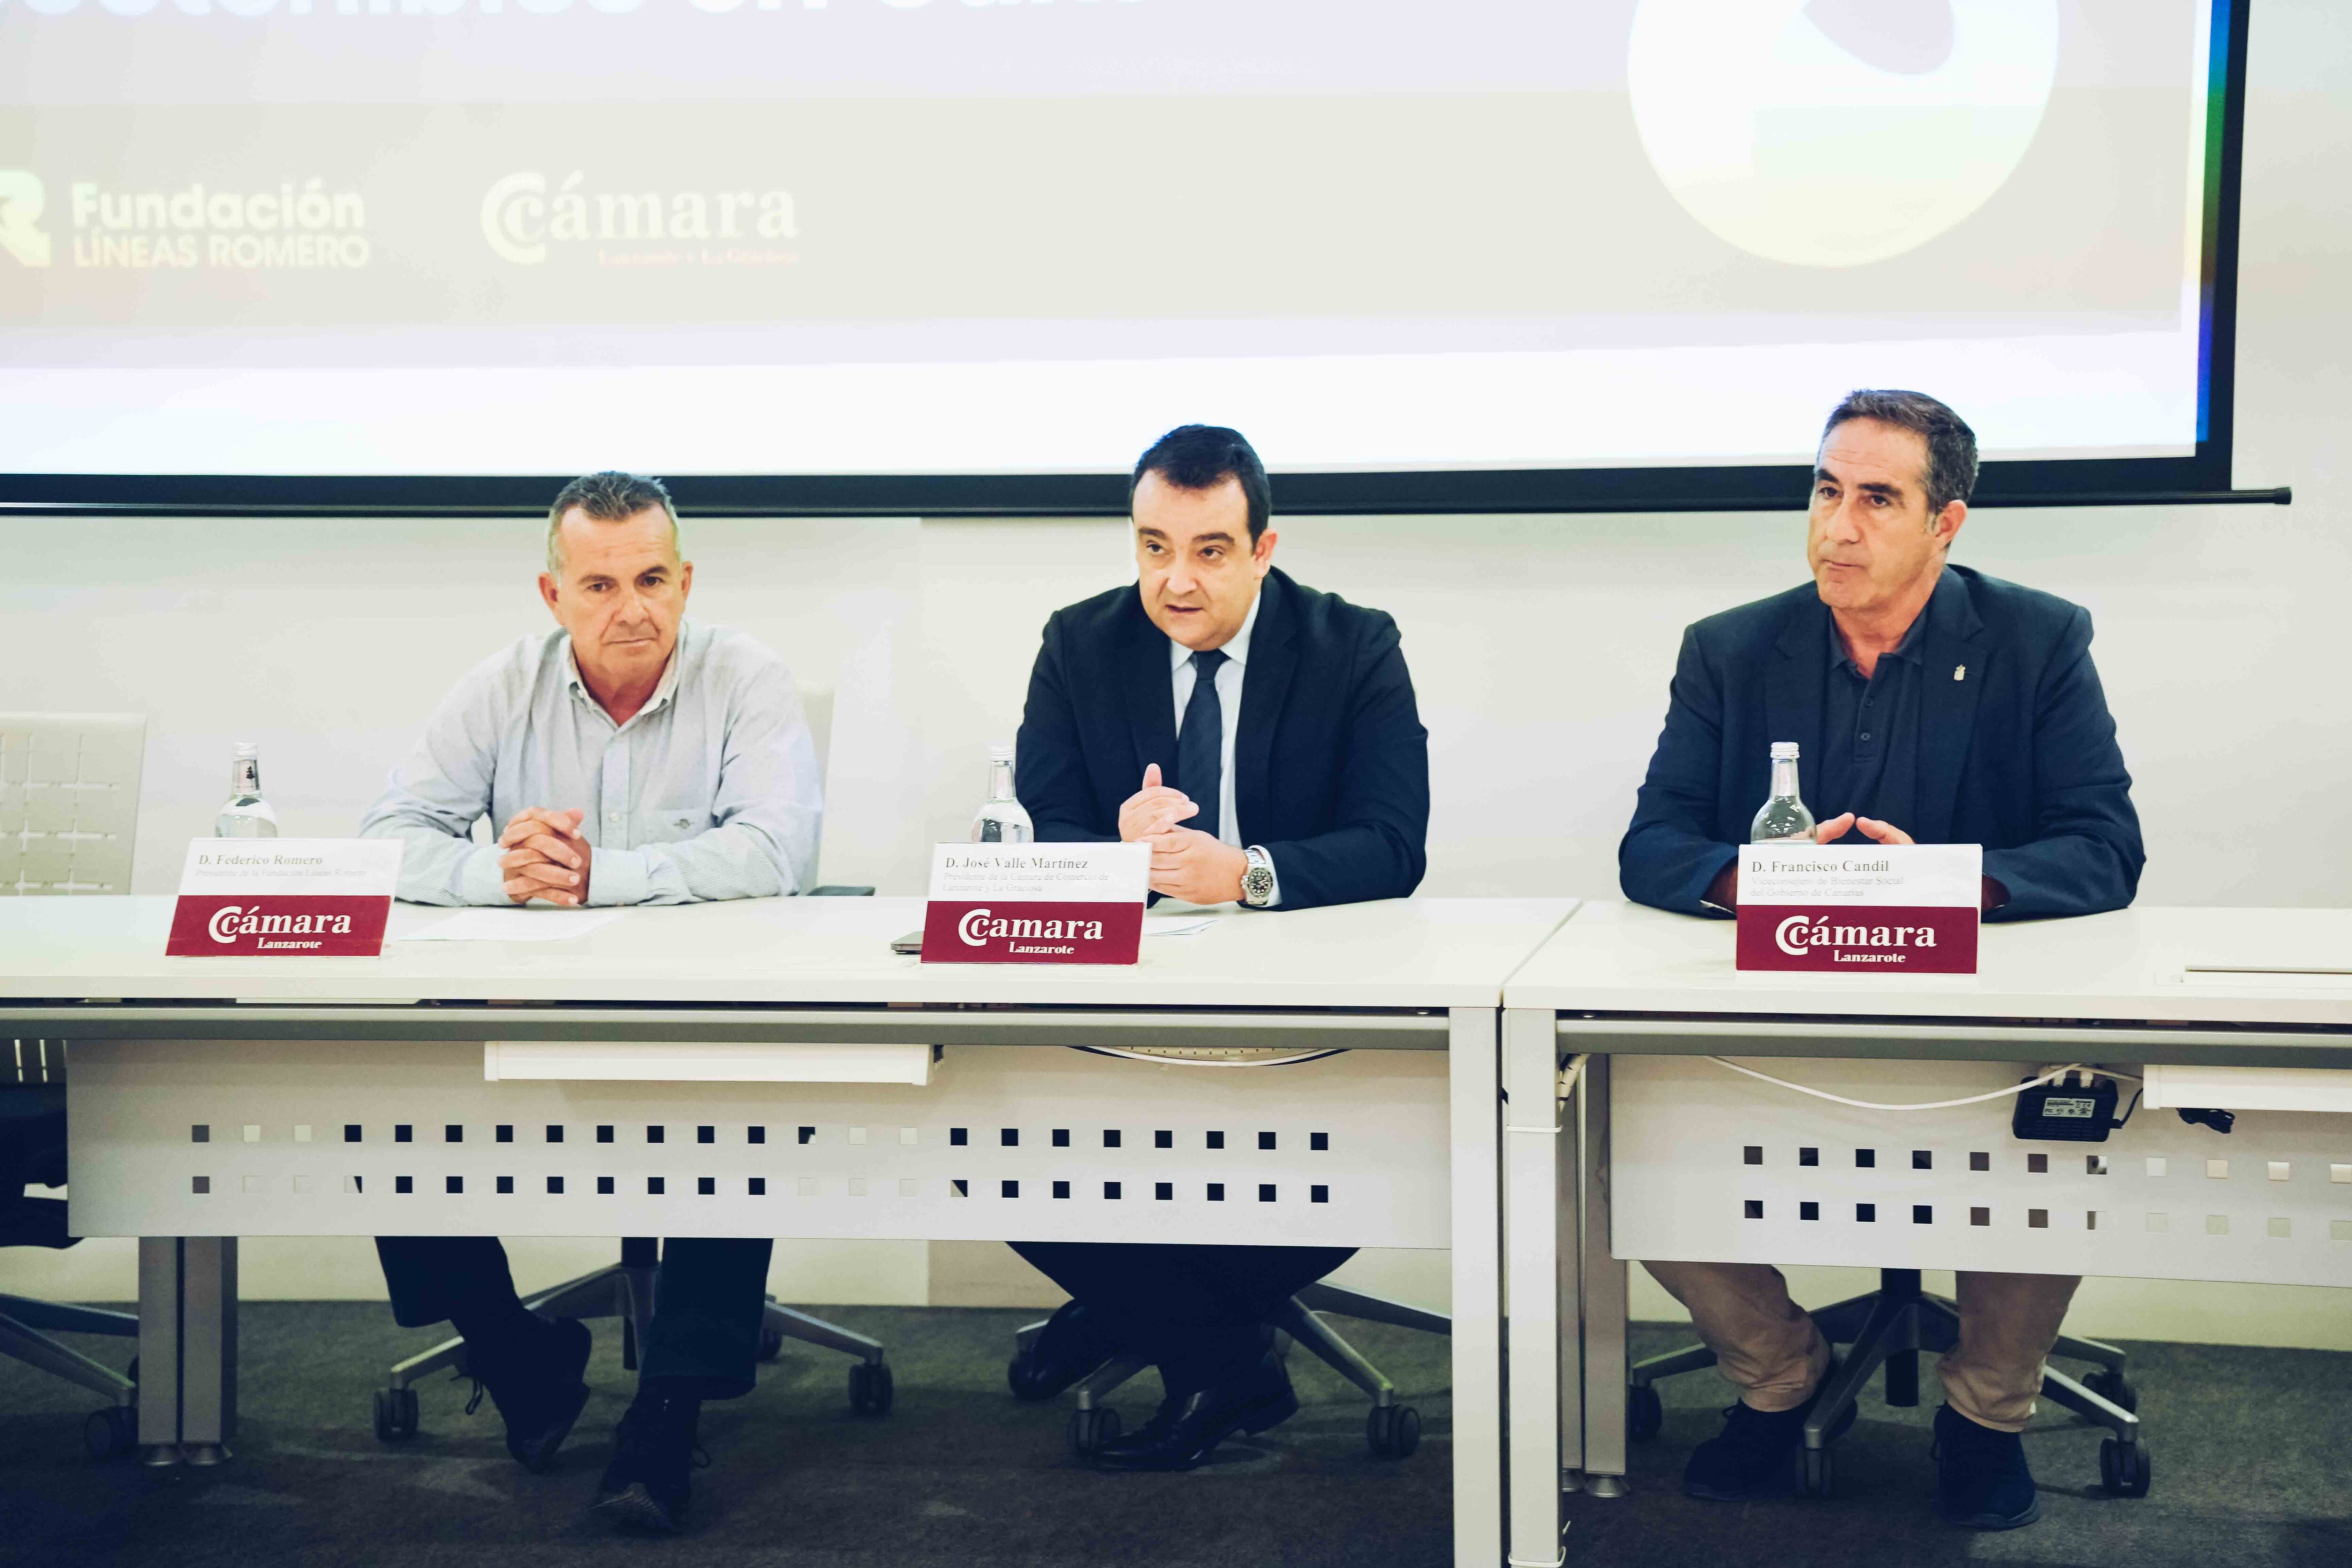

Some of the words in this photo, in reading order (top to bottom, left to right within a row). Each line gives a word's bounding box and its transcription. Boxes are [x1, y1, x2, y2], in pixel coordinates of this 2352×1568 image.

[73, 178, 366, 230] Fundación
[74, 228, 198, 267] LÍNEAS
[209, 233, 369, 267] ROMERO
[199, 854, 211, 865] D.
[217, 854, 270, 865] Federico
[274, 854, 323, 865] Romero
[946, 858, 958, 868] D.
[962, 857, 990, 868] José
[995, 858, 1026, 868] Valle
[1030, 858, 1089, 868] Martínez
[1752, 861, 1766, 872] D.
[1772, 861, 1837, 872] Francisco
[1843, 860, 1889, 872] Candil
[1876, 876, 1904, 884] Social
[257, 937, 322, 949] Lanzarote
[1009, 941, 1074, 955] Lanzarote
[1834, 950, 1906, 963] Lanzarote
